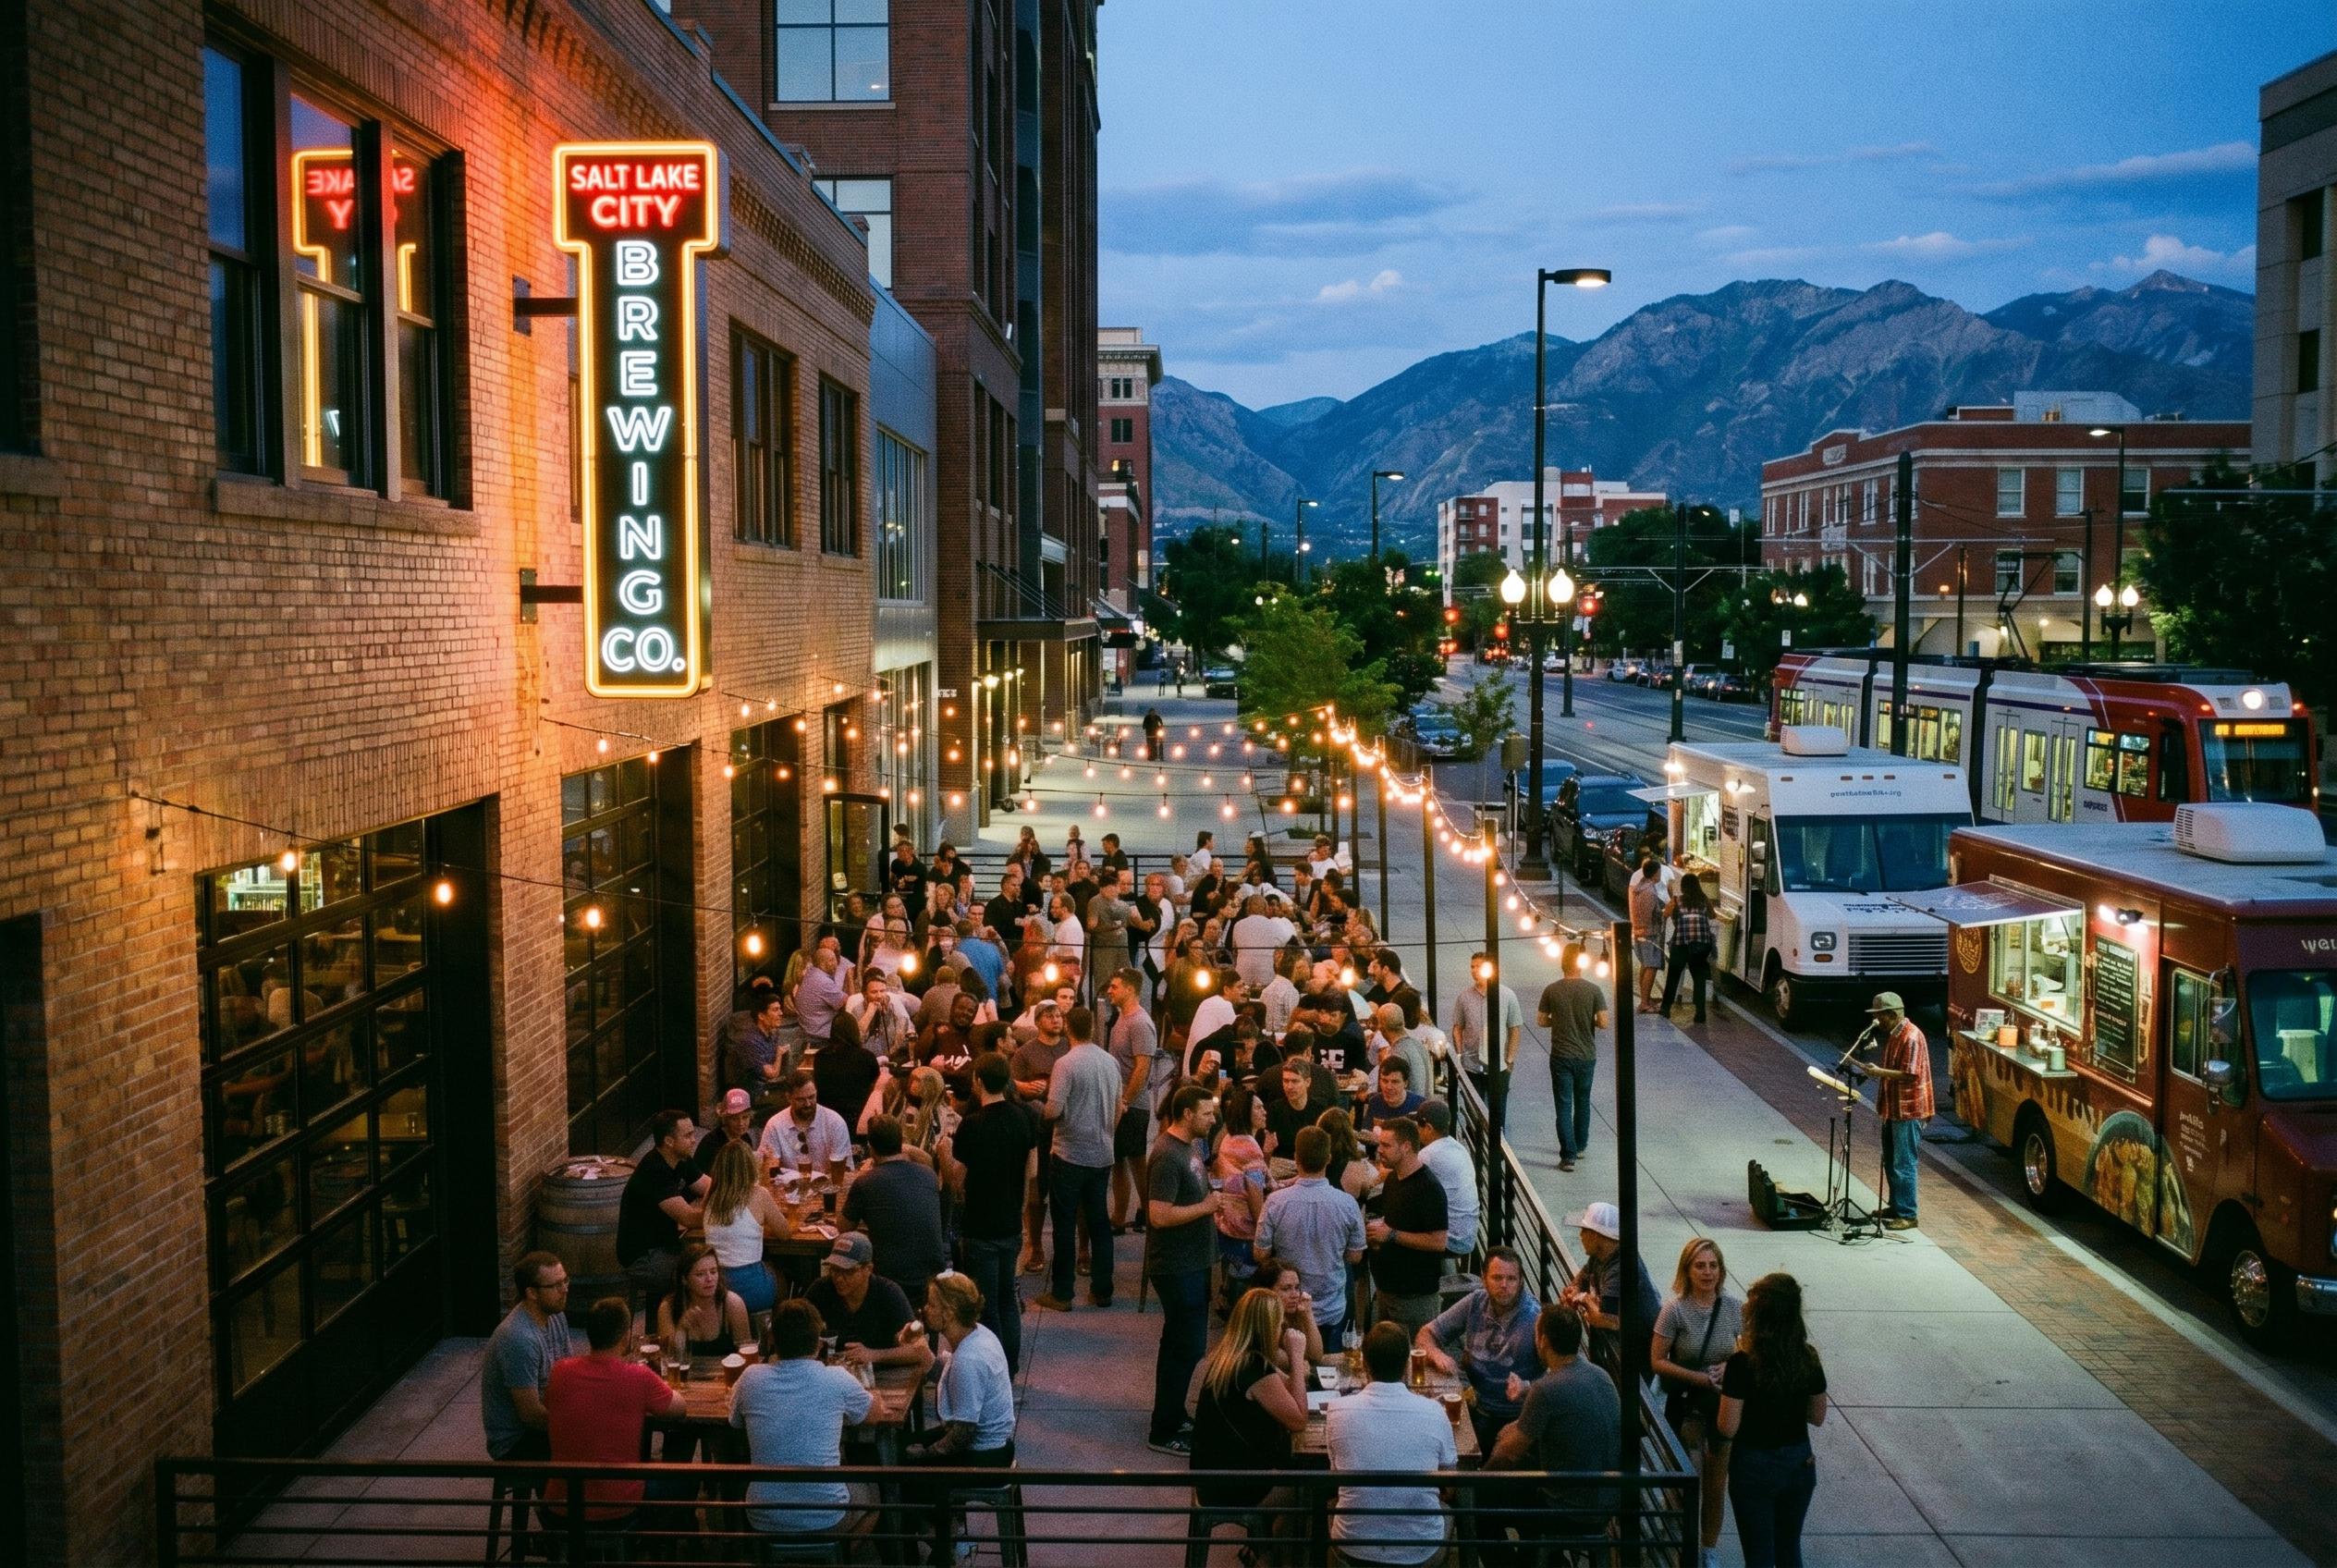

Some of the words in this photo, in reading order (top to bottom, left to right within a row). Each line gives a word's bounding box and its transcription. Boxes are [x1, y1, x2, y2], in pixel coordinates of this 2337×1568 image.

[570, 165, 630, 190] SALT
[636, 165, 700, 190] LAKE
[591, 195, 681, 227] CITY
[607, 240, 671, 615] BREWING
[602, 627, 686, 672] CO.
